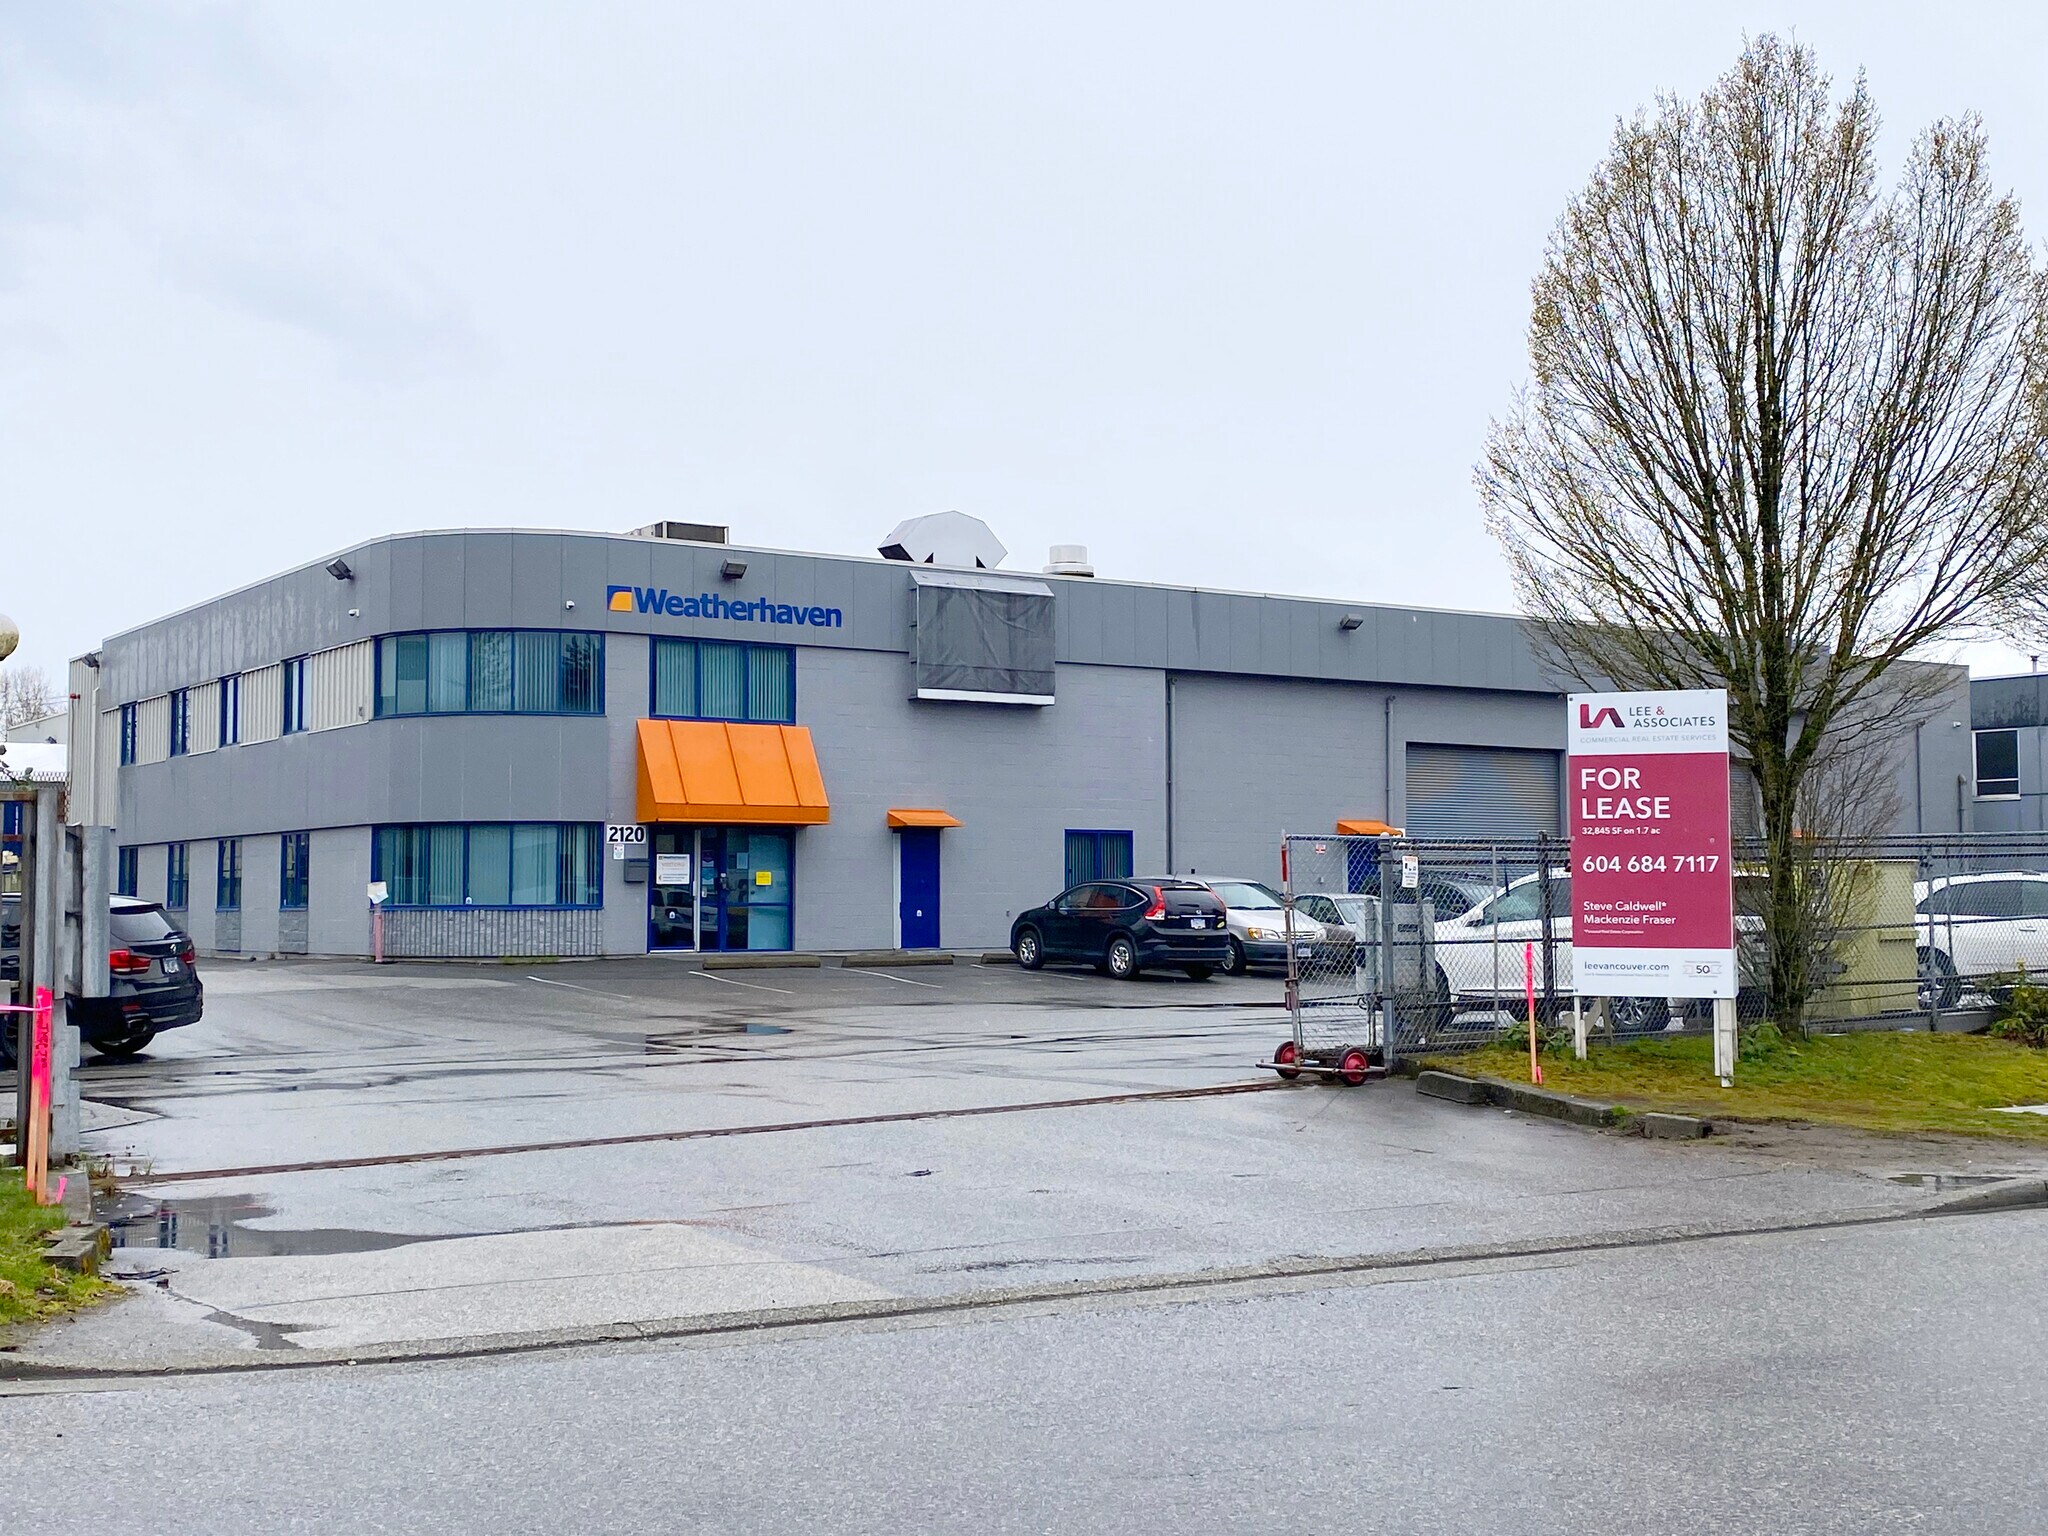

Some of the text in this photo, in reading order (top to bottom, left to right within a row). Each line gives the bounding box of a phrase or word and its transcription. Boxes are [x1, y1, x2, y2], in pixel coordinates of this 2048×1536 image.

[634, 586, 842, 628] Weatherhaven
[1629, 706, 1665, 717] LEE &
[1633, 716, 1716, 728] ASSOCIATES
[1580, 736, 1630, 744] COMMERCIAL
[1681, 734, 1717, 742] SERVICES
[1581, 768, 1641, 790] FOR
[1581, 796, 1671, 820] LEASE
[608, 826, 645, 843] 2120
[1582, 826, 1610, 836] 32,845
[1611, 827, 1622, 835] SF
[1636, 827, 1649, 835] 1.7
[1582, 855, 1719, 873] 604 684 7117
[1583, 901, 1612, 911] Steve
[1583, 914, 1676, 925] Mackenzie Fraser
[1584, 961, 1670, 971] leevancouver.com
[1696, 965, 1711, 974] 50
